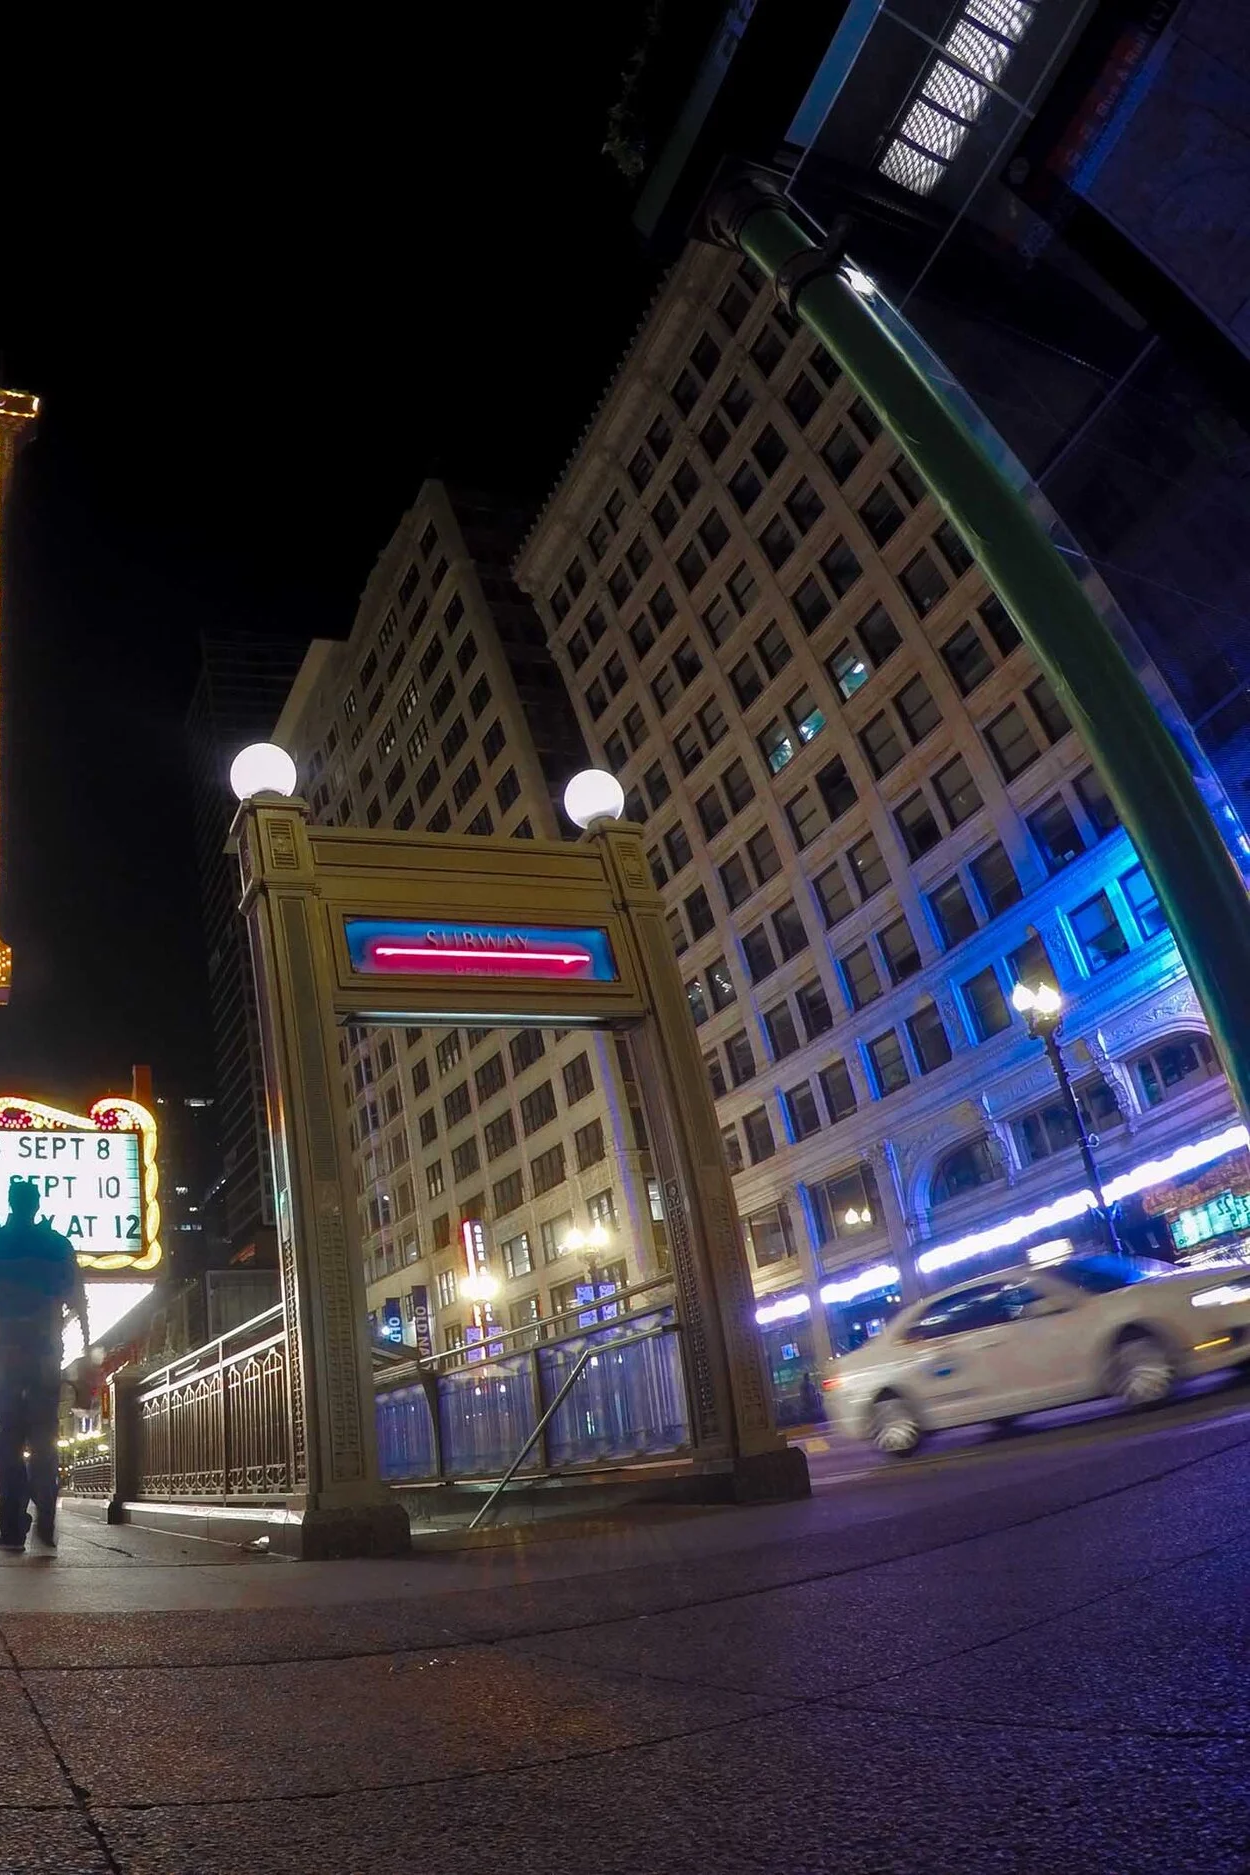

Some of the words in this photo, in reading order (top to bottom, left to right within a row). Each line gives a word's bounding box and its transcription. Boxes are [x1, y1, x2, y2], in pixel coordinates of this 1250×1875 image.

[18, 1136, 85, 1160] SEPT
[96, 1138, 110, 1160] 8
[9, 1174, 77, 1199] PT
[98, 1177, 121, 1199] 10
[65, 1215, 97, 1238] AT
[114, 1214, 142, 1239] 12
[388, 1316, 401, 1343] OLD
[415, 1306, 427, 1333] OLD
